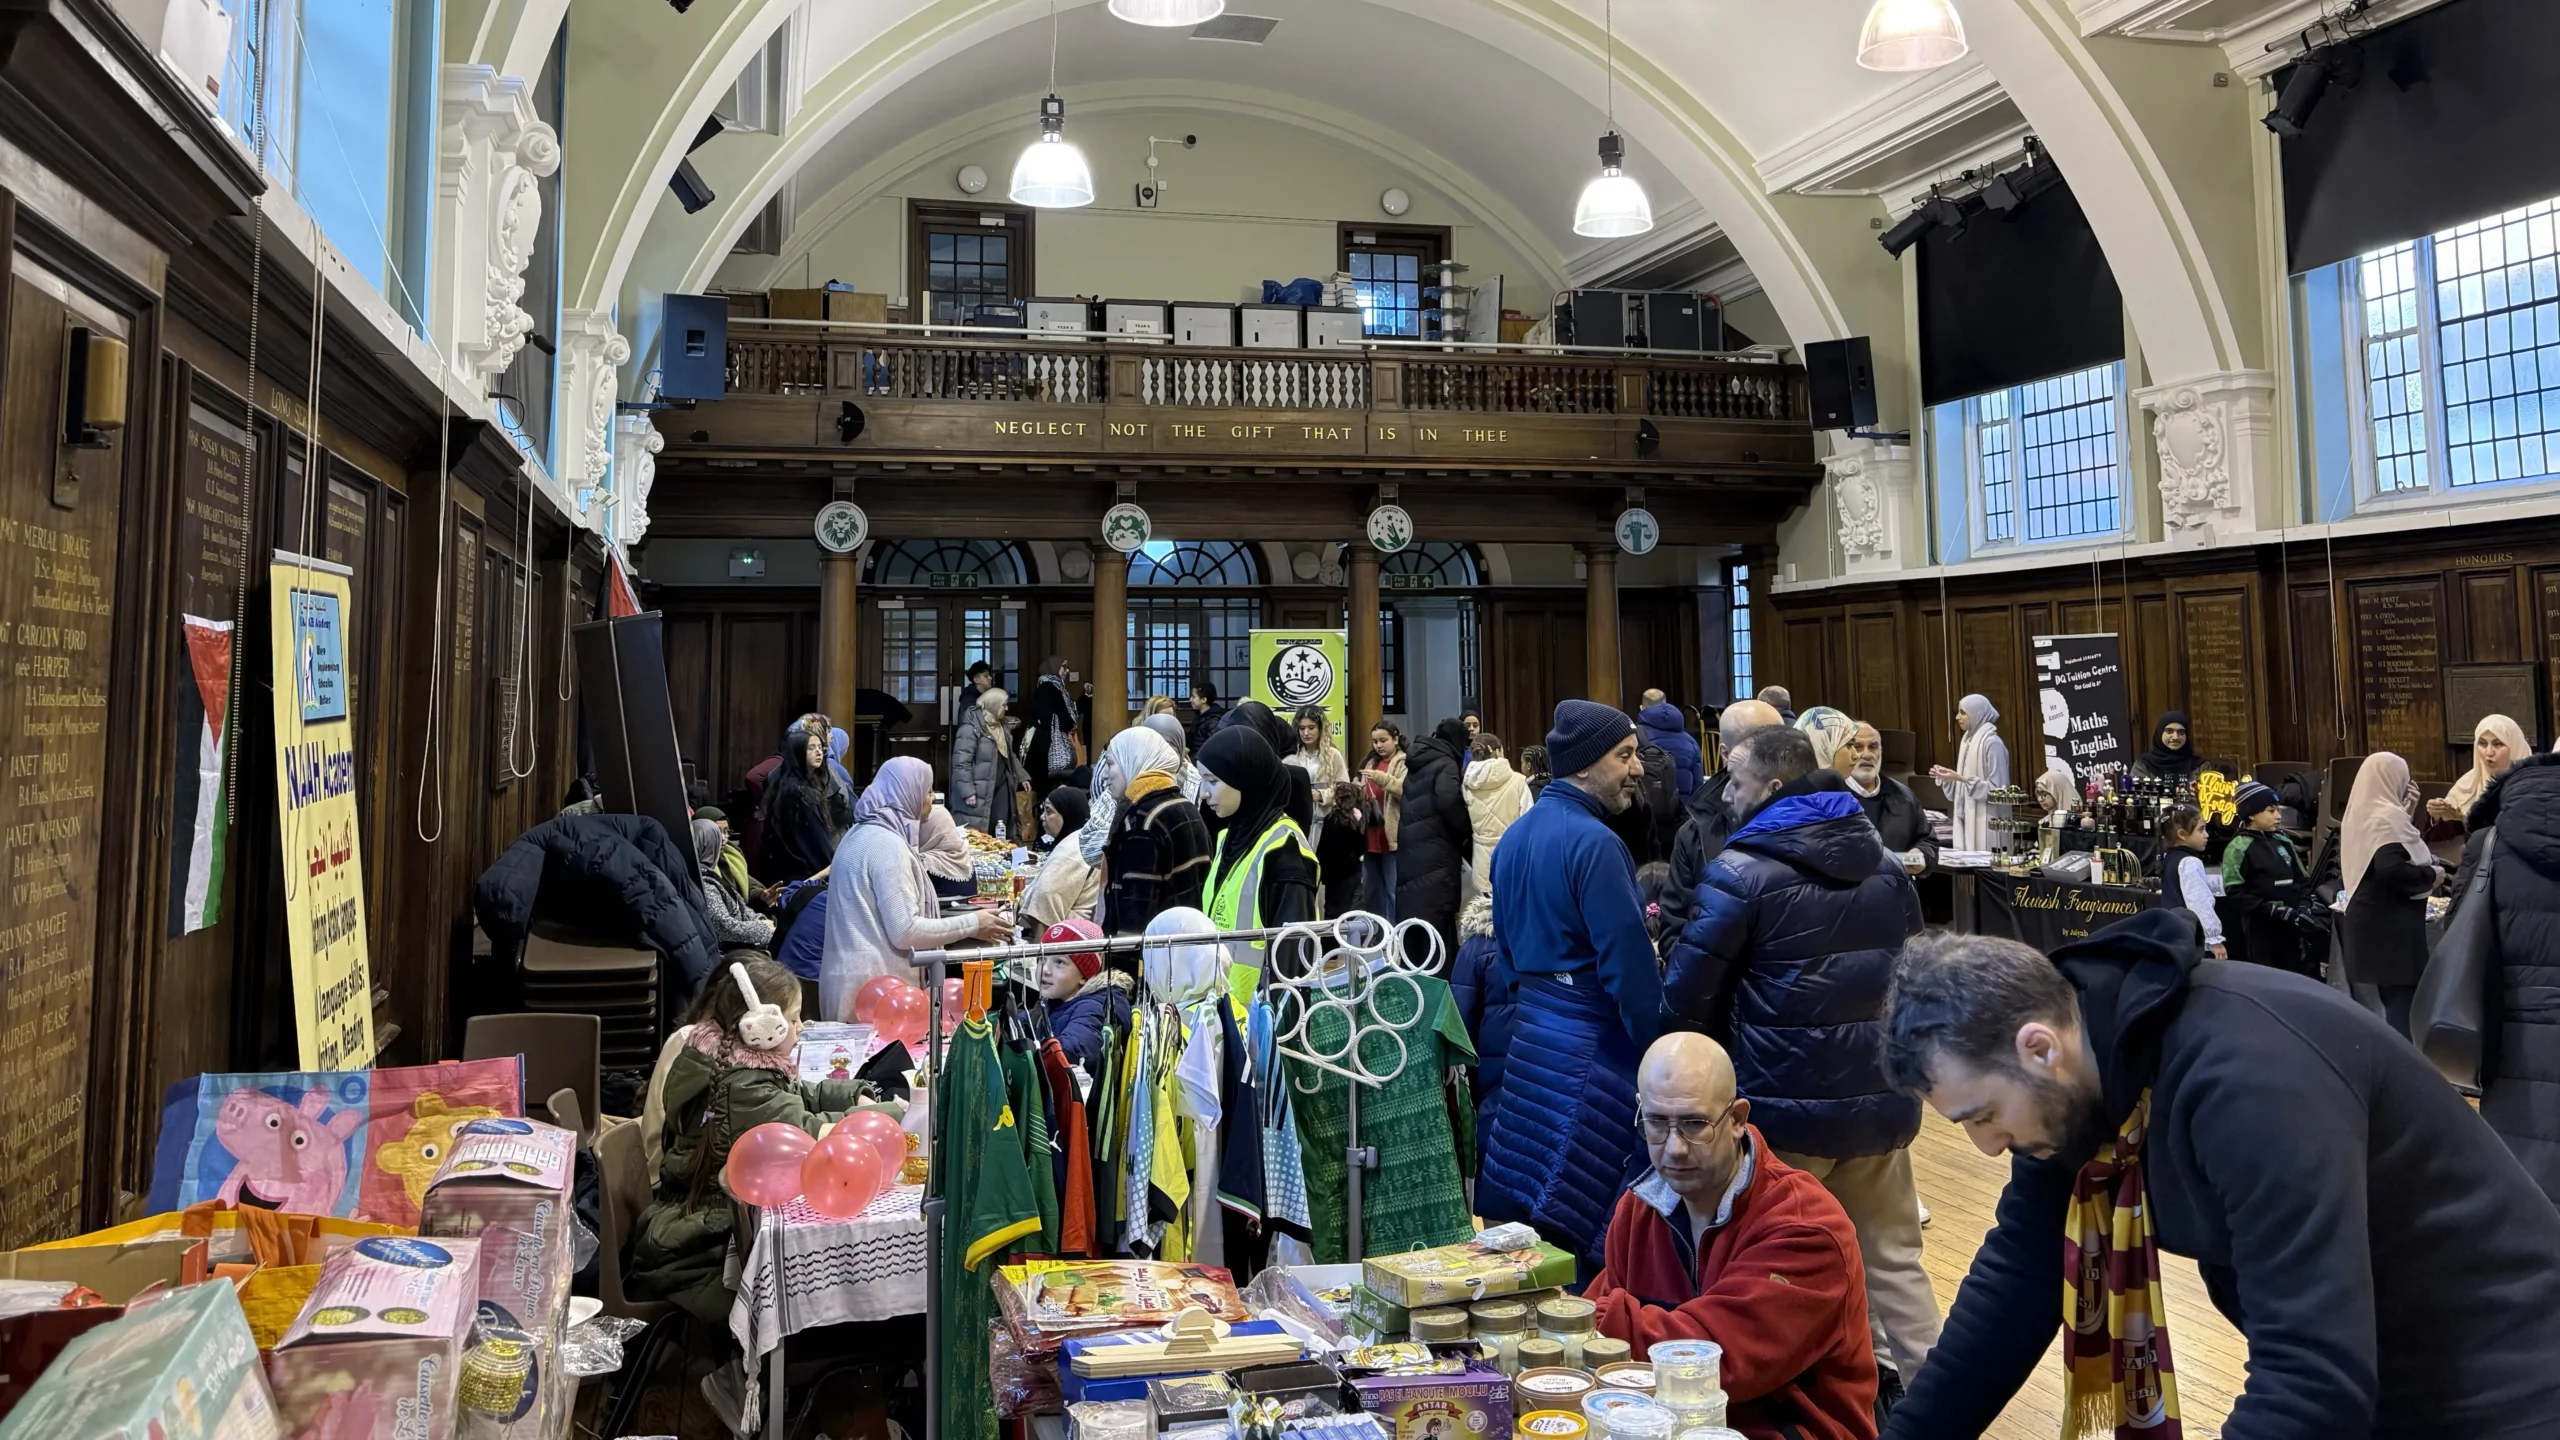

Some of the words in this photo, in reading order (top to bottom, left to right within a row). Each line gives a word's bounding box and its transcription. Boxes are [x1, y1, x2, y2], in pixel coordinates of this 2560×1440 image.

[271, 387, 291, 418] LONG
[995, 421, 1087, 436] NEGLECT
[1110, 423, 1148, 436] NOT
[1172, 424, 1206, 438] THE
[1231, 425, 1275, 439] GIFT
[1302, 427, 1352, 440] THAT
[1379, 428, 1396, 440] IS
[1420, 428, 1438, 441] IN
[1463, 430, 1508, 442] THEE
[201, 435, 218, 456] SUSAN
[220, 444, 240, 467] WALTERS
[24, 524, 57, 552] MERIAL
[62, 534, 91, 559] DRAKE
[2456, 552, 2513, 566] HONOURS
[17, 623, 59, 648] CAROLYN
[63, 629, 87, 650] FORD
[33, 655, 70, 678] HARPER
[2055, 675, 2066, 685] DQ
[2066, 671, 2091, 682] Tuition
[2092, 665, 2118, 675] Centre
[24, 716, 55, 742] University
[1332, 718, 1342, 735] ust
[2049, 712, 2064, 721] Assess
[2070, 712, 2109, 733] Maths
[2070, 733, 2118, 758] English
[10, 755, 38, 780] JANET
[43, 752, 68, 775] HOAD
[322, 738, 355, 800] Academ
[2076, 760, 2122, 778] Science
[74, 779, 95, 799] Essex
[4, 822, 34, 852] JANET
[39, 815, 81, 842] JOHNSON
[2011, 885, 2060, 909] Flourish
[2064, 888, 2138, 922] Fragrances
[36, 912, 68, 942] MAGEE
[7, 982, 43, 1010] University
[320, 976, 348, 1024] language
[0, 1019, 37, 1056] AUREEN
[42, 1005, 70, 1037] PEASE
[342, 1013, 364, 1060] Reading
[35, 1032, 77, 1068] Portsmouth
[46, 1088, 82, 1128] RHODES
[54, 1125, 80, 1153] London
[0, 1191, 27, 1226] NIFER
[32, 1170, 58, 1205] BUCK
[532, 1200, 553, 1253] Caissette
[518, 1233, 534, 1250] de
[514, 1250, 533, 1291] Luxe
[530, 1255, 541, 1270] en
[522, 1274, 544, 1320] Papier
[416, 1353, 441, 1417] Caissette
[1379, 1390, 1394, 1402] RAS
[1395, 1389, 1405, 1401] EL
[1405, 1387, 1444, 1401] HANOUTE
[1449, 1384, 1488, 1398] MOULU
[1417, 1402, 1447, 1411] ANTAR
